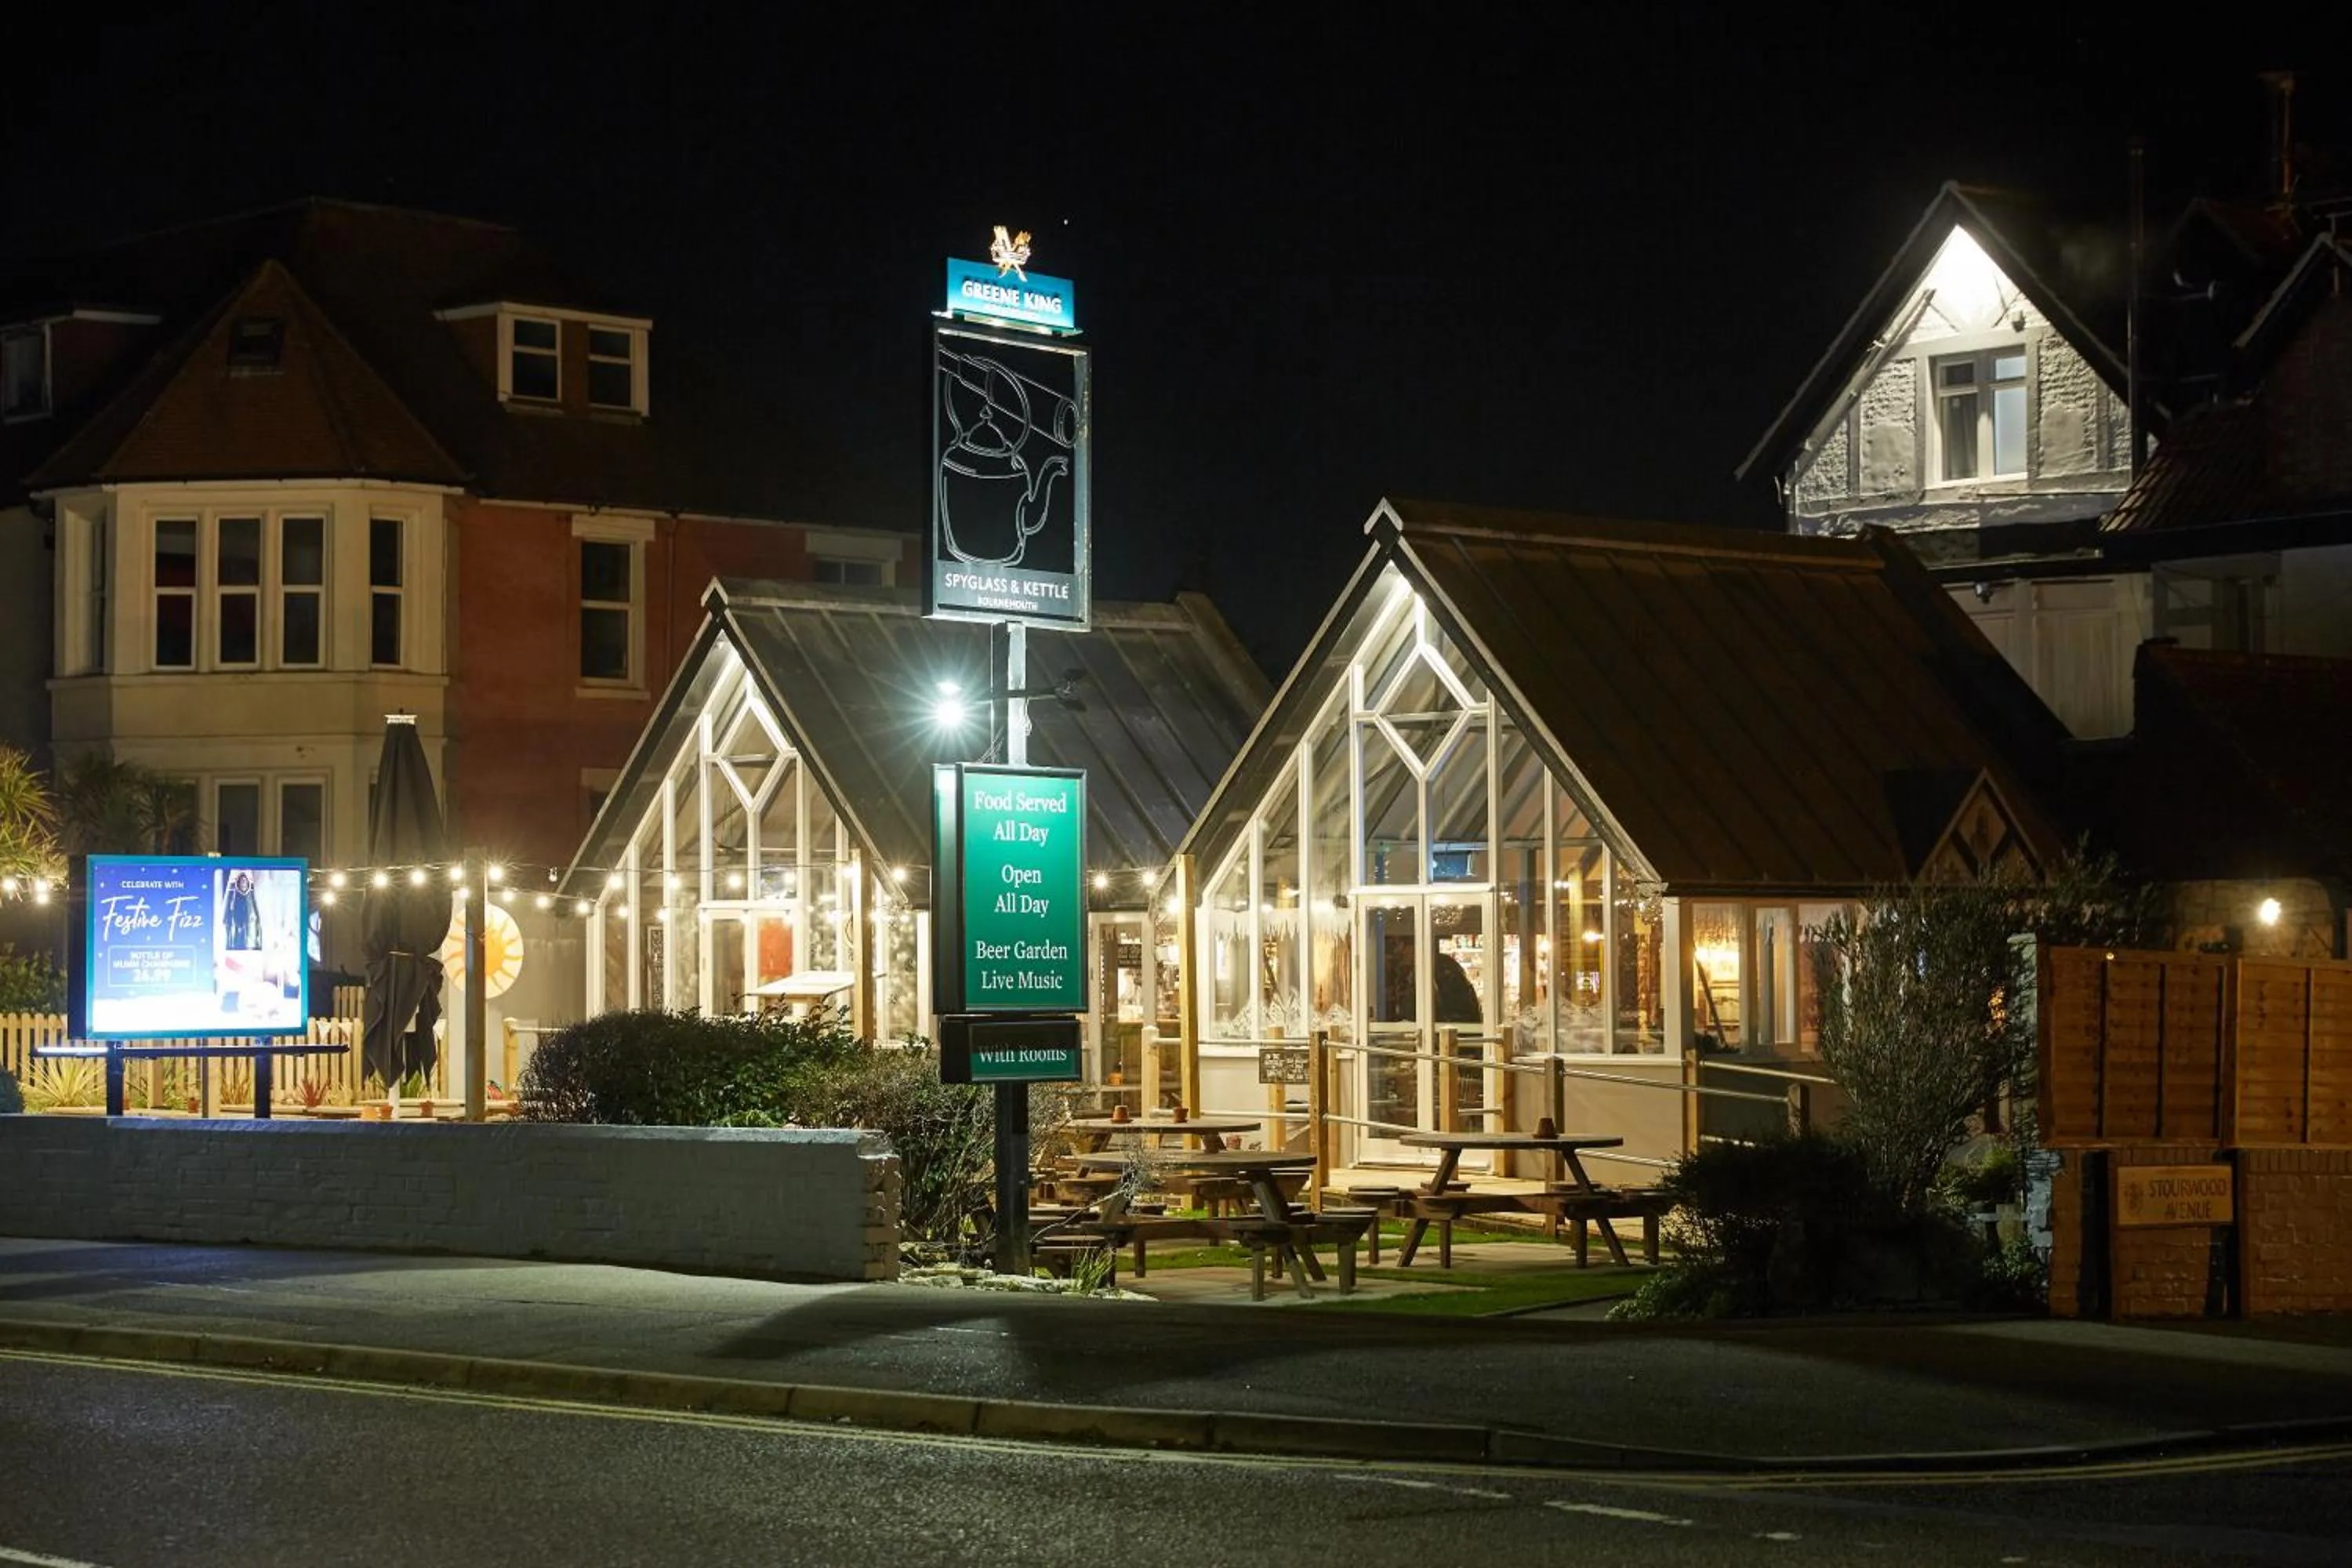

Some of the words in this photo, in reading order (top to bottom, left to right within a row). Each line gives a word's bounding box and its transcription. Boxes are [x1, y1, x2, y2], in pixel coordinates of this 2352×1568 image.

[961, 280, 1020, 305] GREENE
[1024, 291, 1062, 314] KING
[945, 573, 1008, 593] SPYGLASS
[1011, 580, 1020, 594] &
[1023, 580, 1069, 600] KETTLE
[978, 597, 1039, 610] BOURNEMOUTH
[975, 791, 1012, 811] Food
[1015, 792, 1067, 813] Served
[993, 821, 1016, 841] All
[1018, 823, 1049, 847] Day
[121, 880, 163, 889] CELEBRATE
[1001, 865, 1042, 887] Open
[994, 895, 1016, 914] All
[1018, 896, 1049, 918] Day
[100, 895, 162, 941] Festive
[165, 895, 203, 941] Fizz
[975, 941, 1011, 960] Beer
[1014, 941, 1067, 960] Garden
[982, 971, 1013, 989] Live
[1018, 971, 1063, 989] Music
[977, 1043, 1014, 1063] With
[1018, 1044, 1067, 1062] Rooms
[2149, 1178, 2227, 1197] STOURWOOD
[2164, 1200, 2212, 1220] AVENUE
